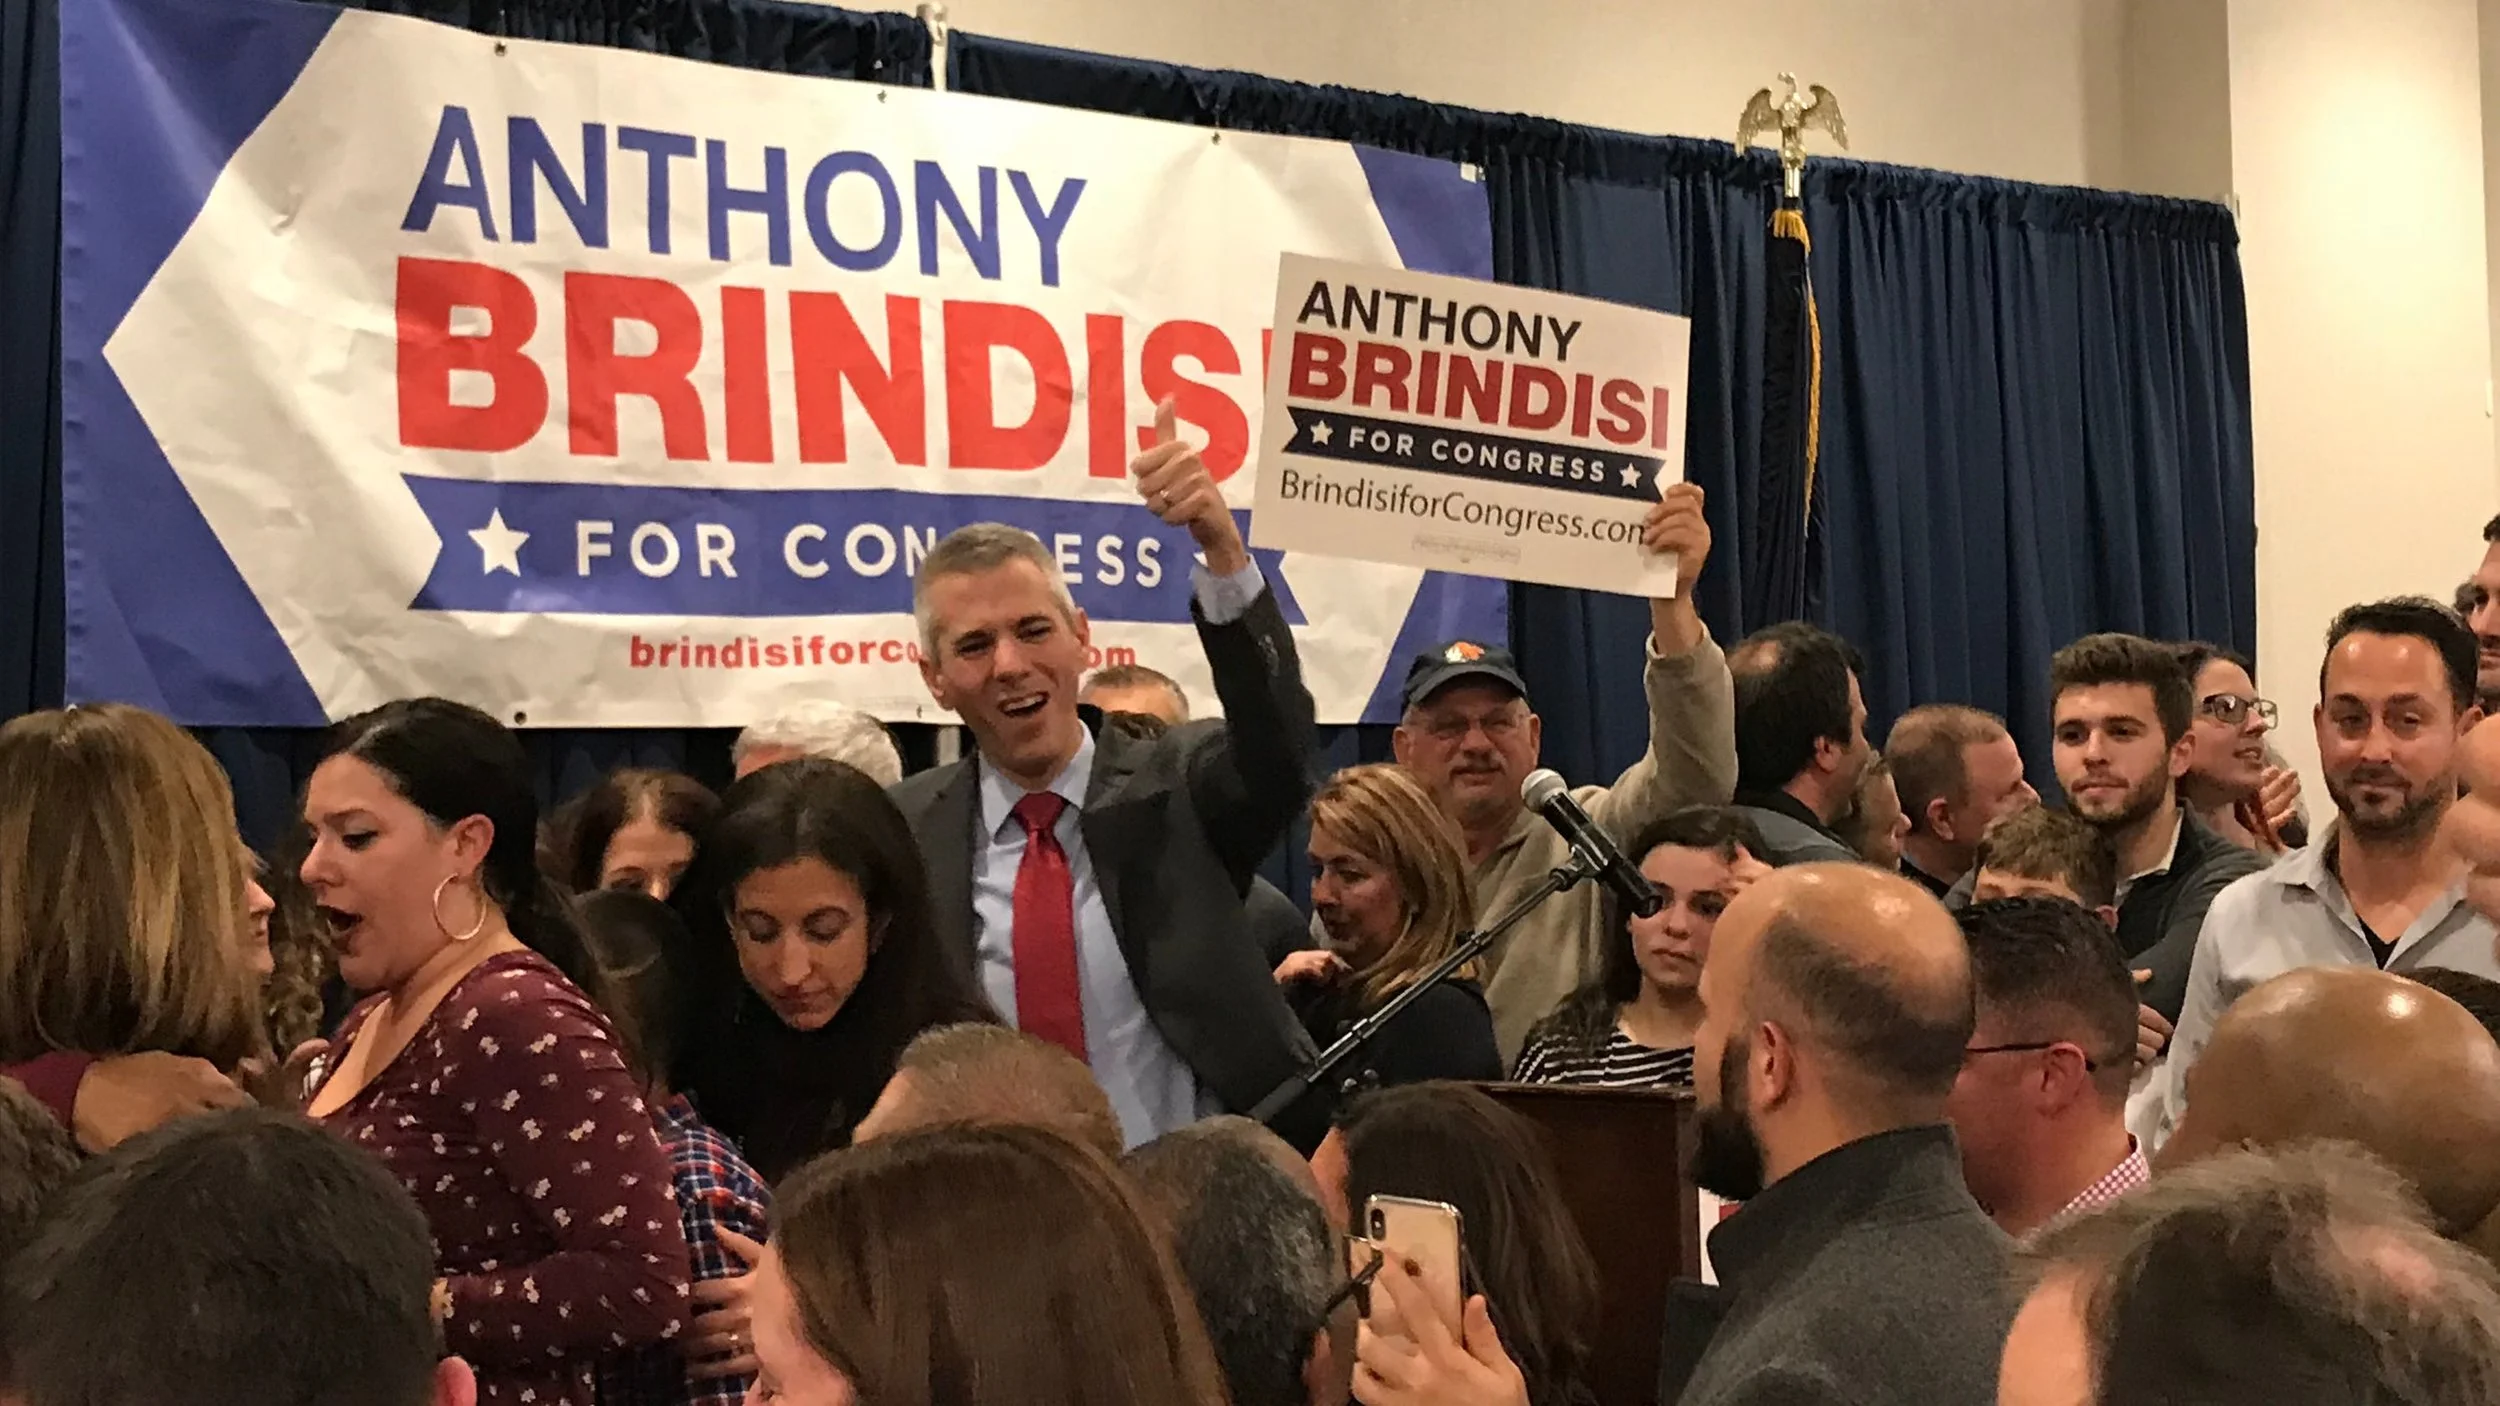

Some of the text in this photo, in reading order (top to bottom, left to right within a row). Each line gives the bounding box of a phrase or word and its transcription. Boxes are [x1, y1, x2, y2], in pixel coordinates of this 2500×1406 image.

[400, 104, 1088, 288] ANTHONY
[395, 255, 1274, 483] BRINDIS
[1297, 280, 1583, 362] ANTHONY
[1287, 330, 1670, 450] BRINDISI
[1348, 426, 1606, 483] FOR CONGRESS
[576, 519, 1163, 589] FOR CONESS
